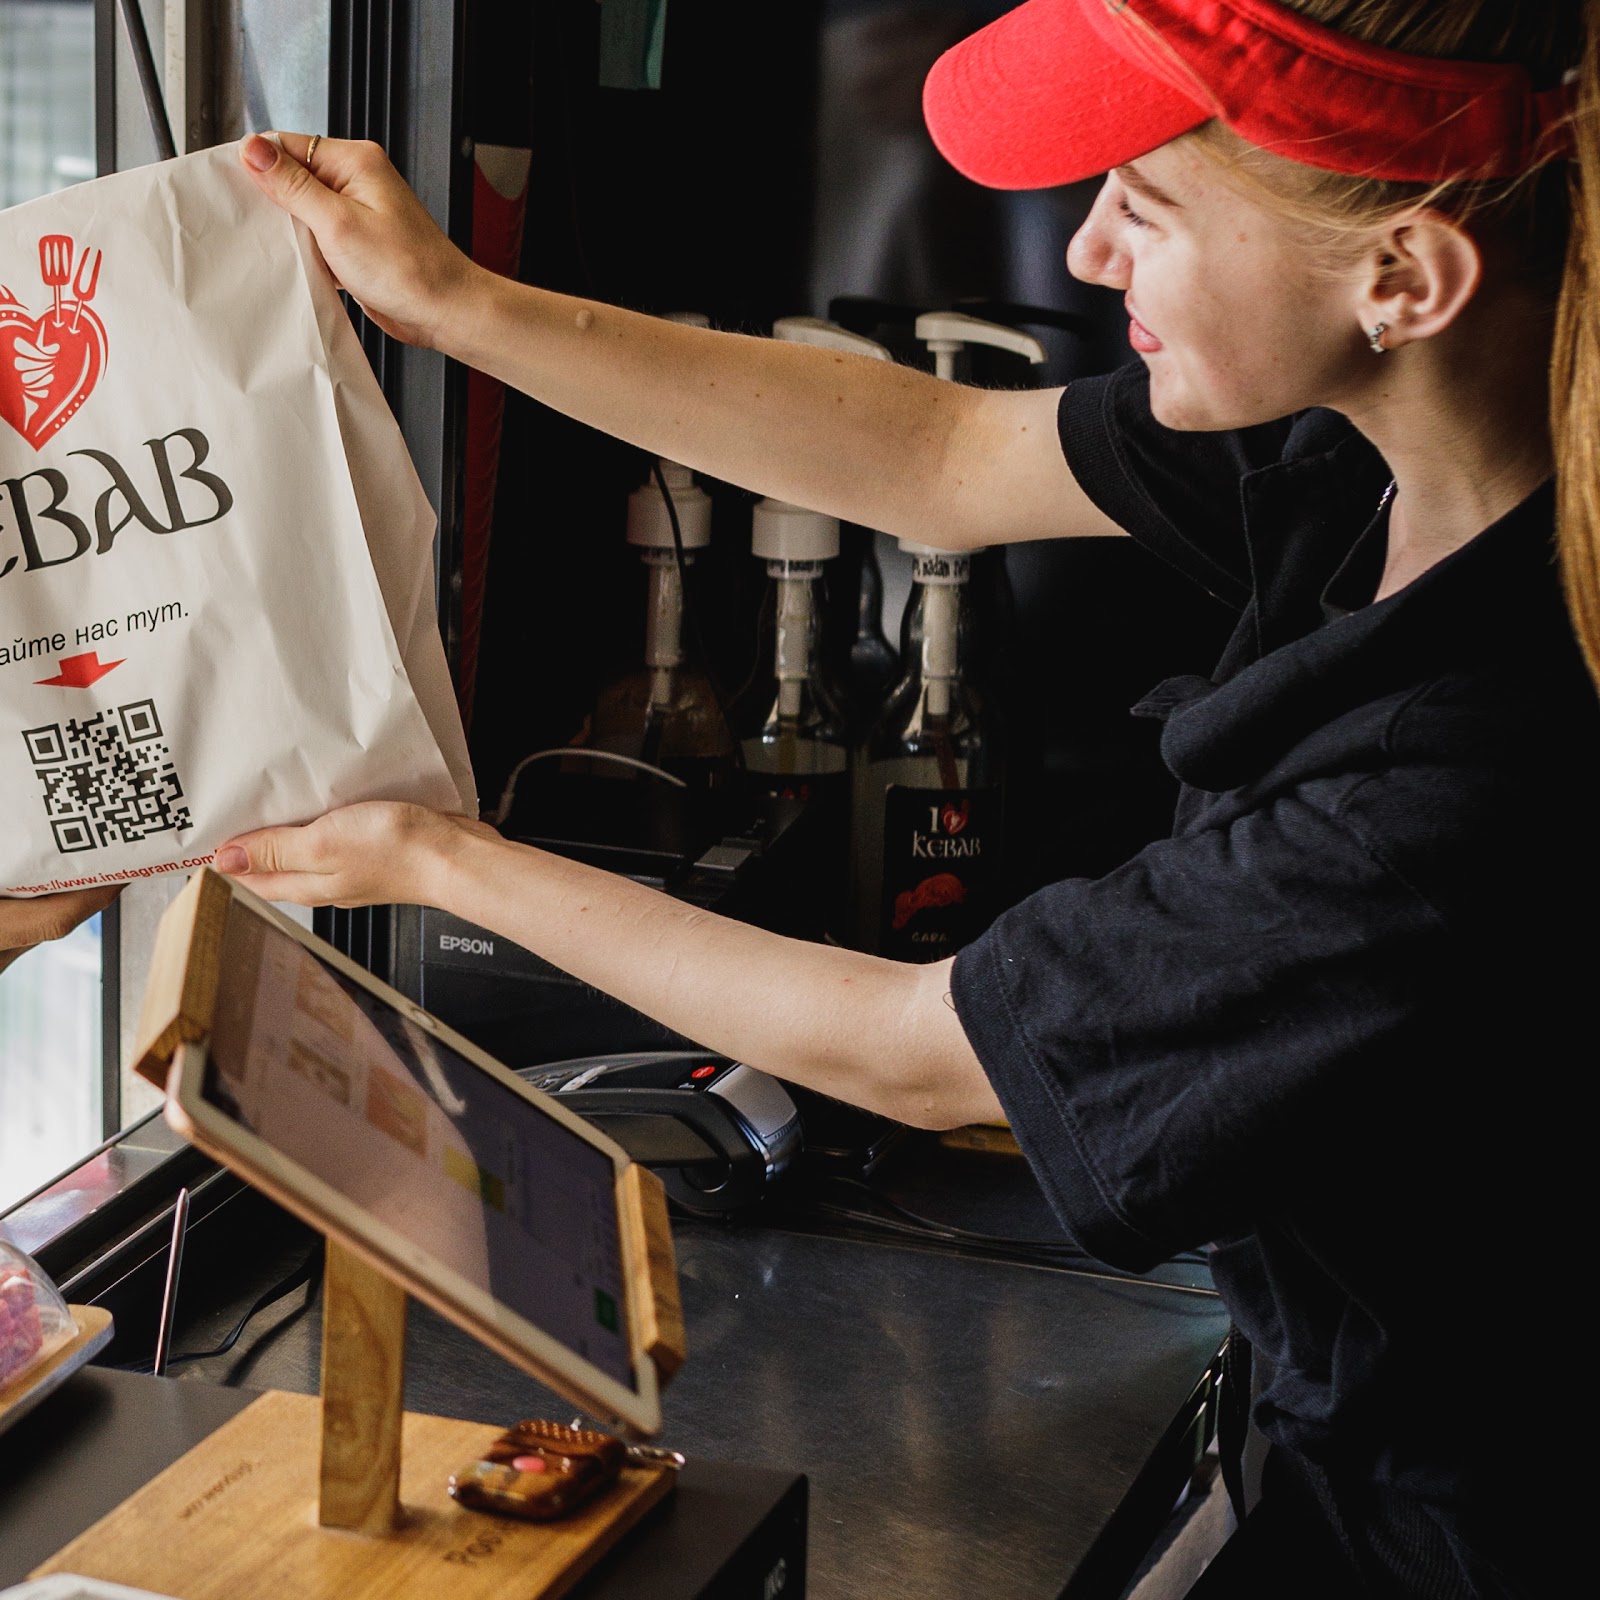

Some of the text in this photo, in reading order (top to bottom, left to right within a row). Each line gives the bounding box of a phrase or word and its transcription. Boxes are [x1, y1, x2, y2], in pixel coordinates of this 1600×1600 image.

[75, 618, 119, 646] нас
[126, 600, 190, 632] тут.
[912, 830, 982, 859] KEBAB
[6, 849, 217, 893] https://www.instagram.com
[440, 935, 494, 956] EPSON
